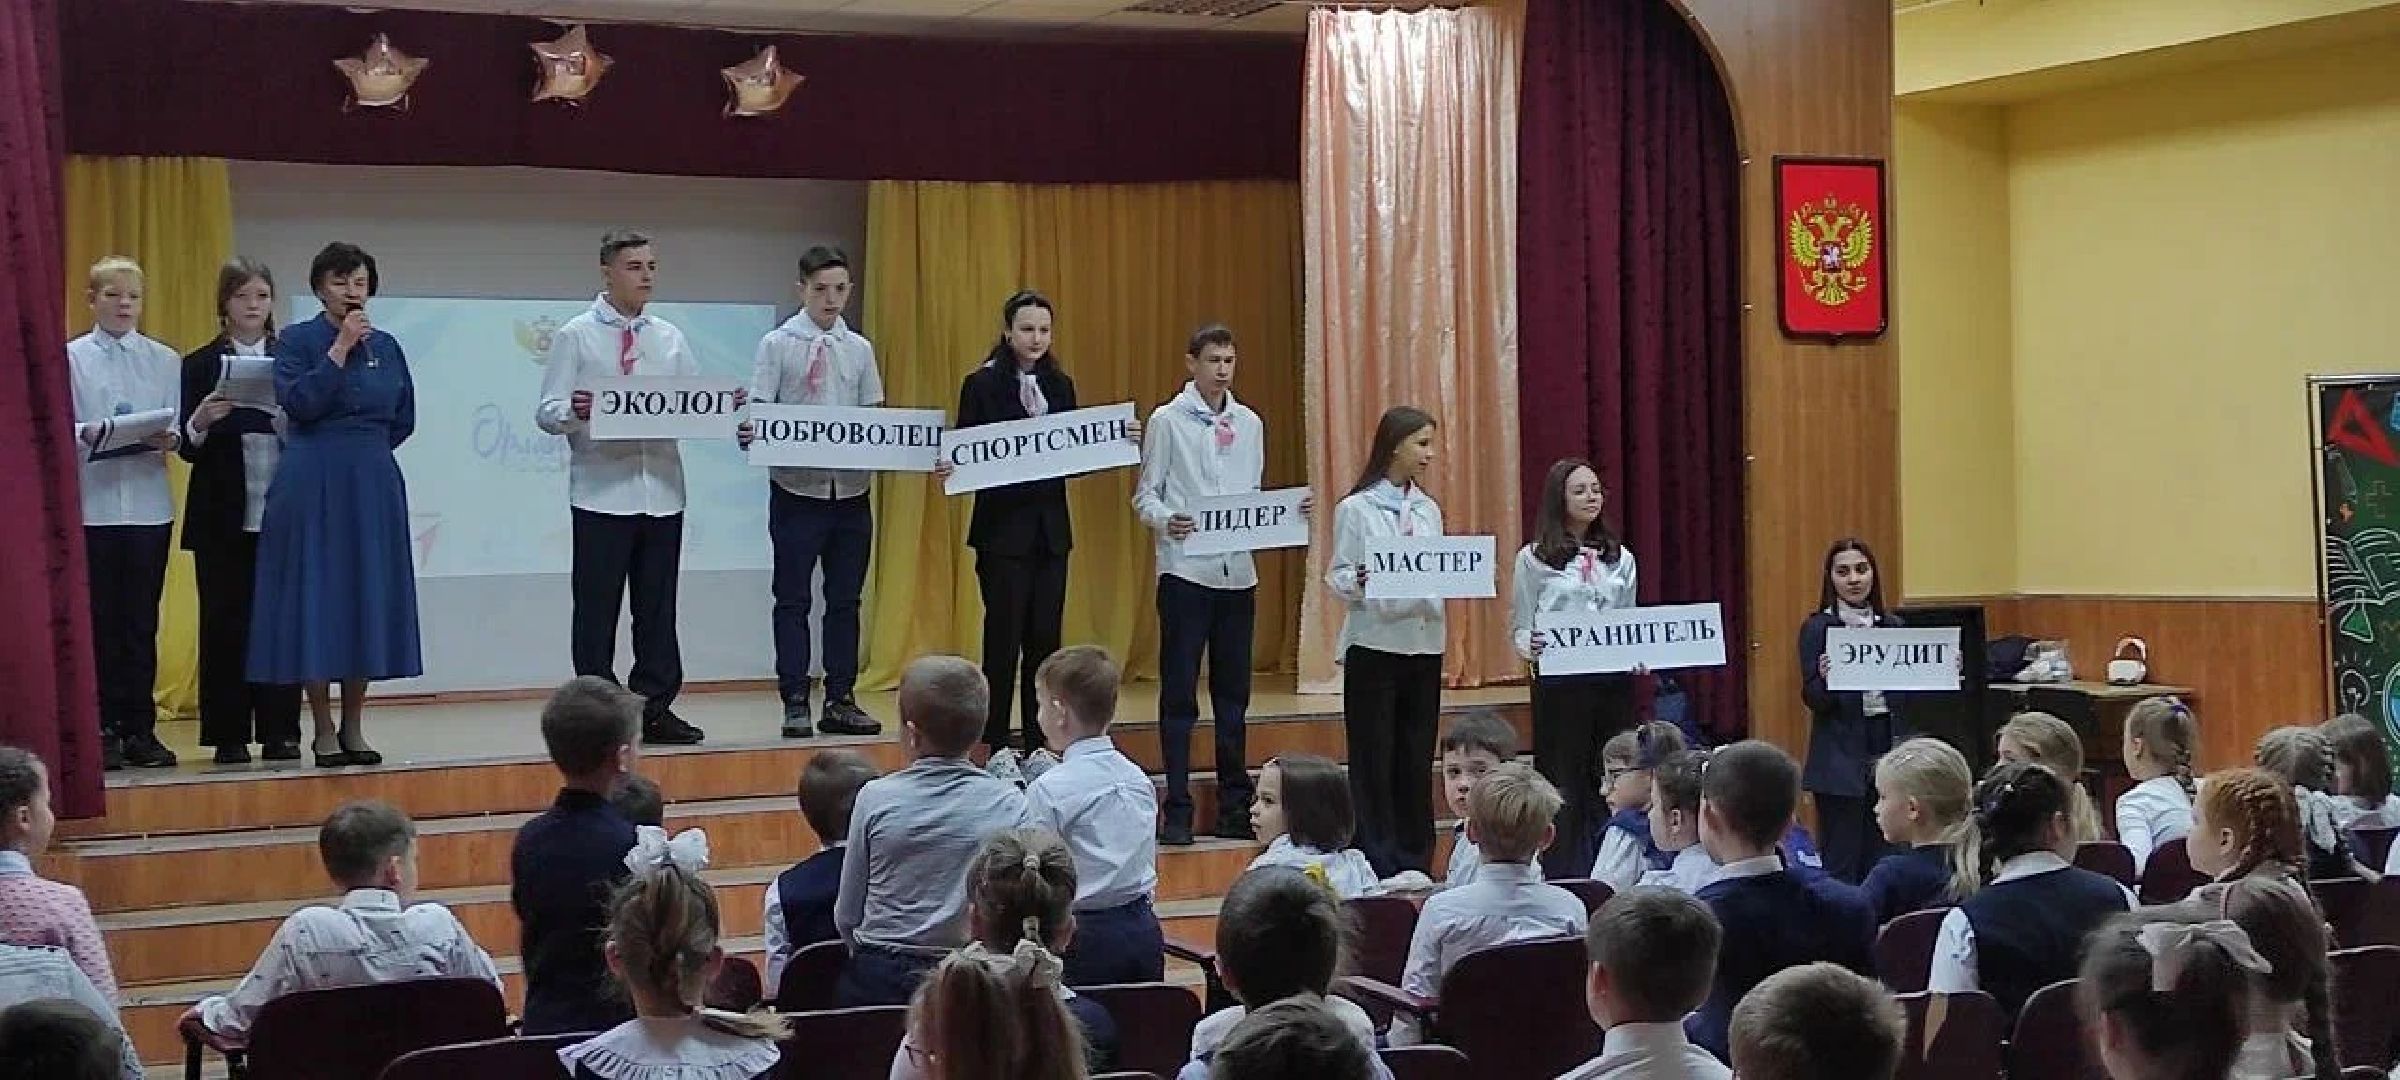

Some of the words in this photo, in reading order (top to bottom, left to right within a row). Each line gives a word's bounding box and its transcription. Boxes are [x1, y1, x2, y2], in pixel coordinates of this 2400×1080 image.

[602, 390, 735, 416] ЭКОЛОГ
[951, 419, 1126, 466] СПОРТСМЕН
[1193, 505, 1287, 532] ЛИДЕР
[1373, 551, 1482, 574] МАСТЕР
[1548, 619, 1716, 648] ХРАНИТЕЛЬ
[1838, 642, 1949, 669] ЭРУДИТ
